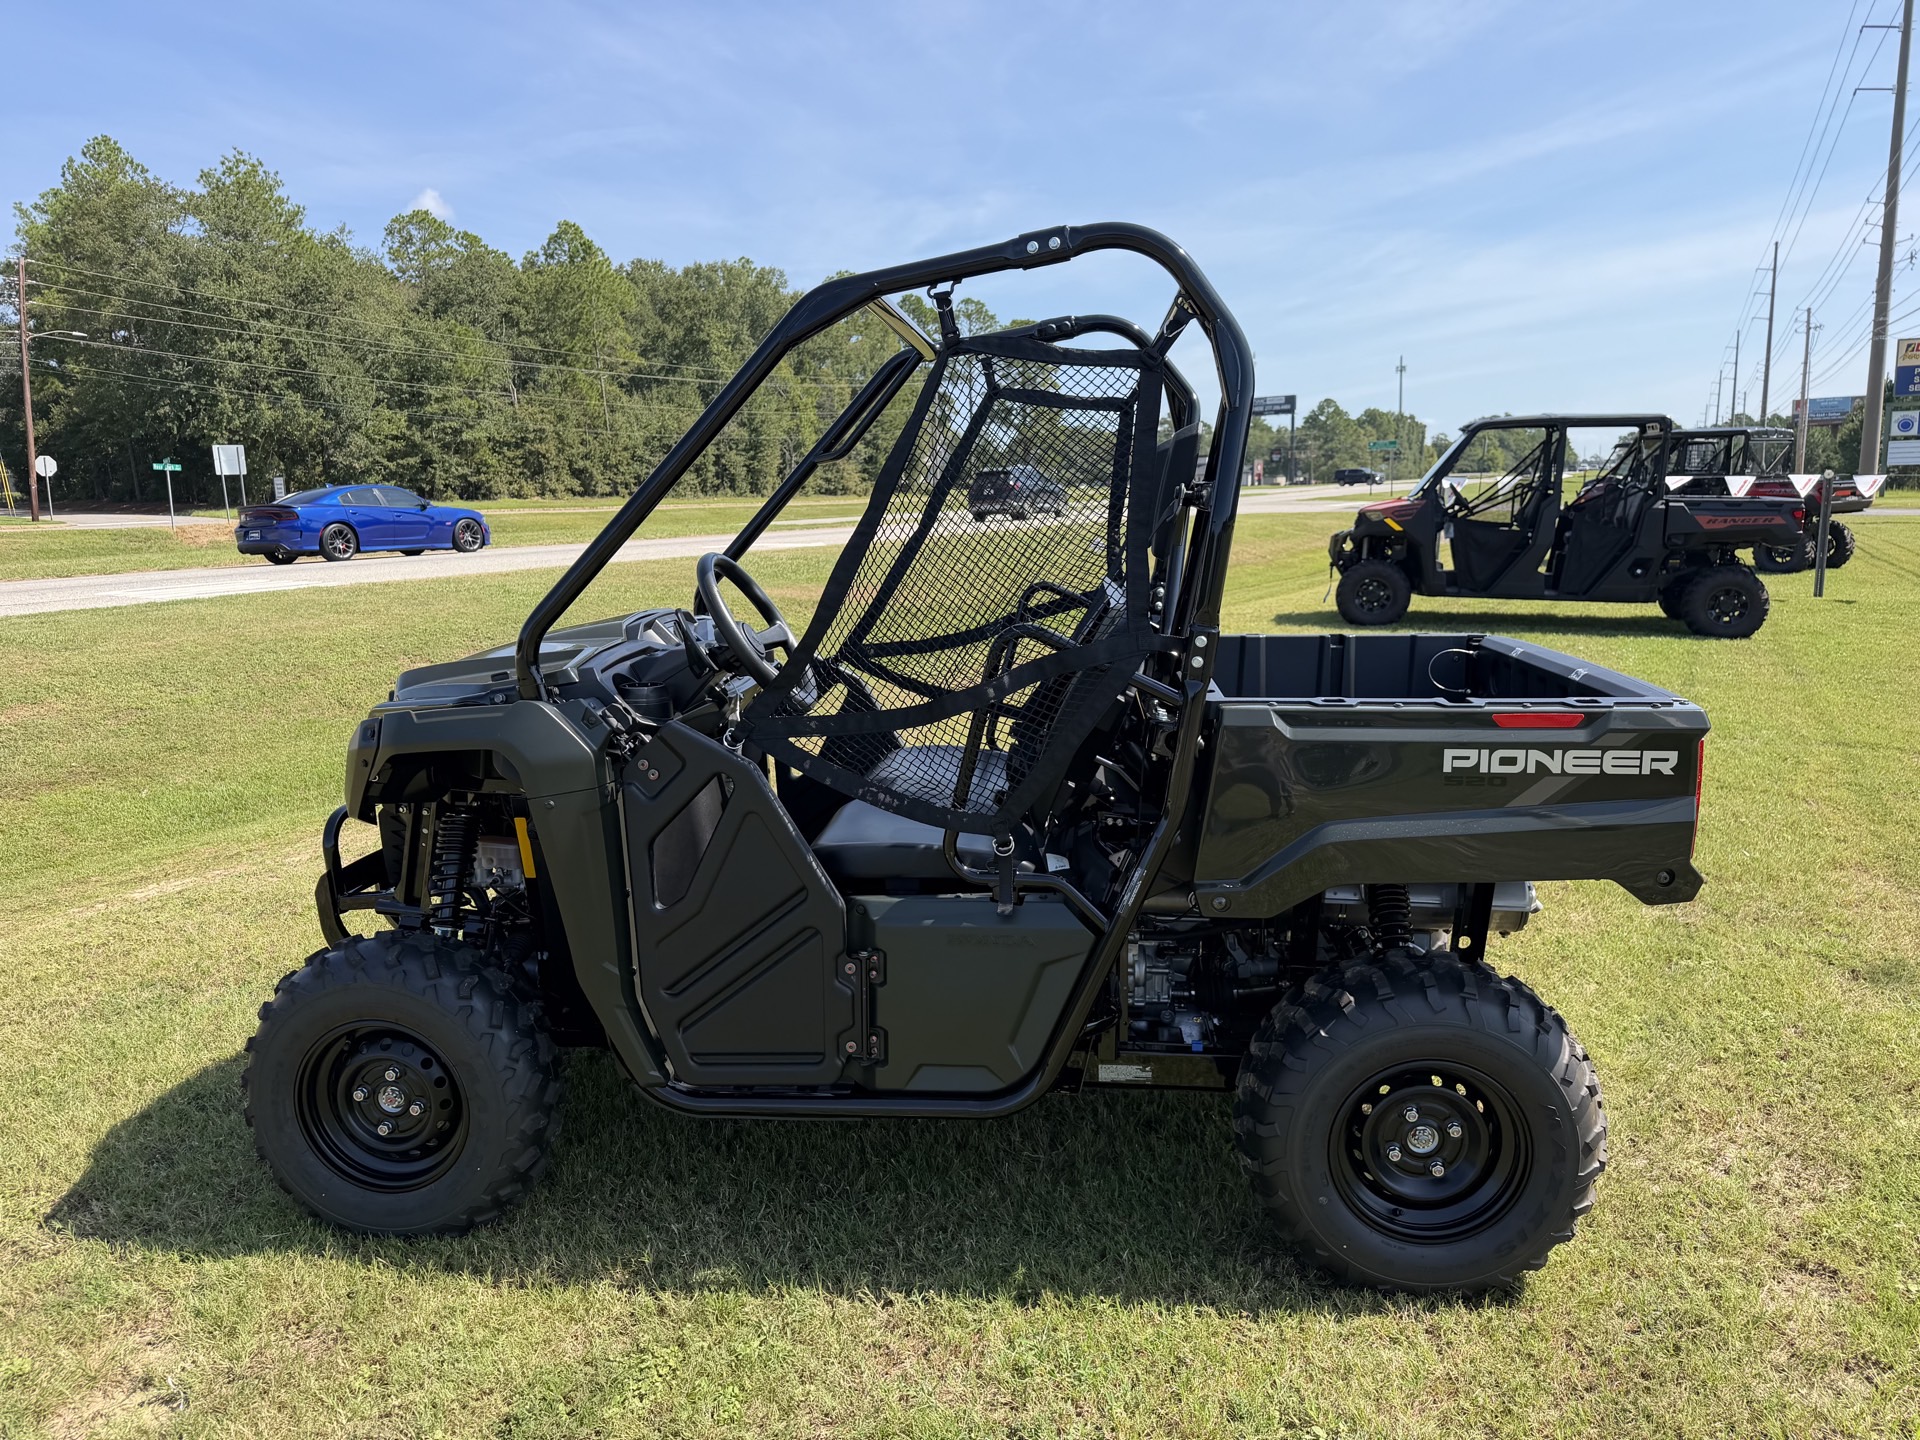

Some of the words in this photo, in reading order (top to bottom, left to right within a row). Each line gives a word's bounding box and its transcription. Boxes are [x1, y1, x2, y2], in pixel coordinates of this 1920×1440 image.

[1706, 517, 1776, 525] RANGER
[1442, 748, 1679, 776] PIONEER
[1443, 776, 1508, 788] 520
